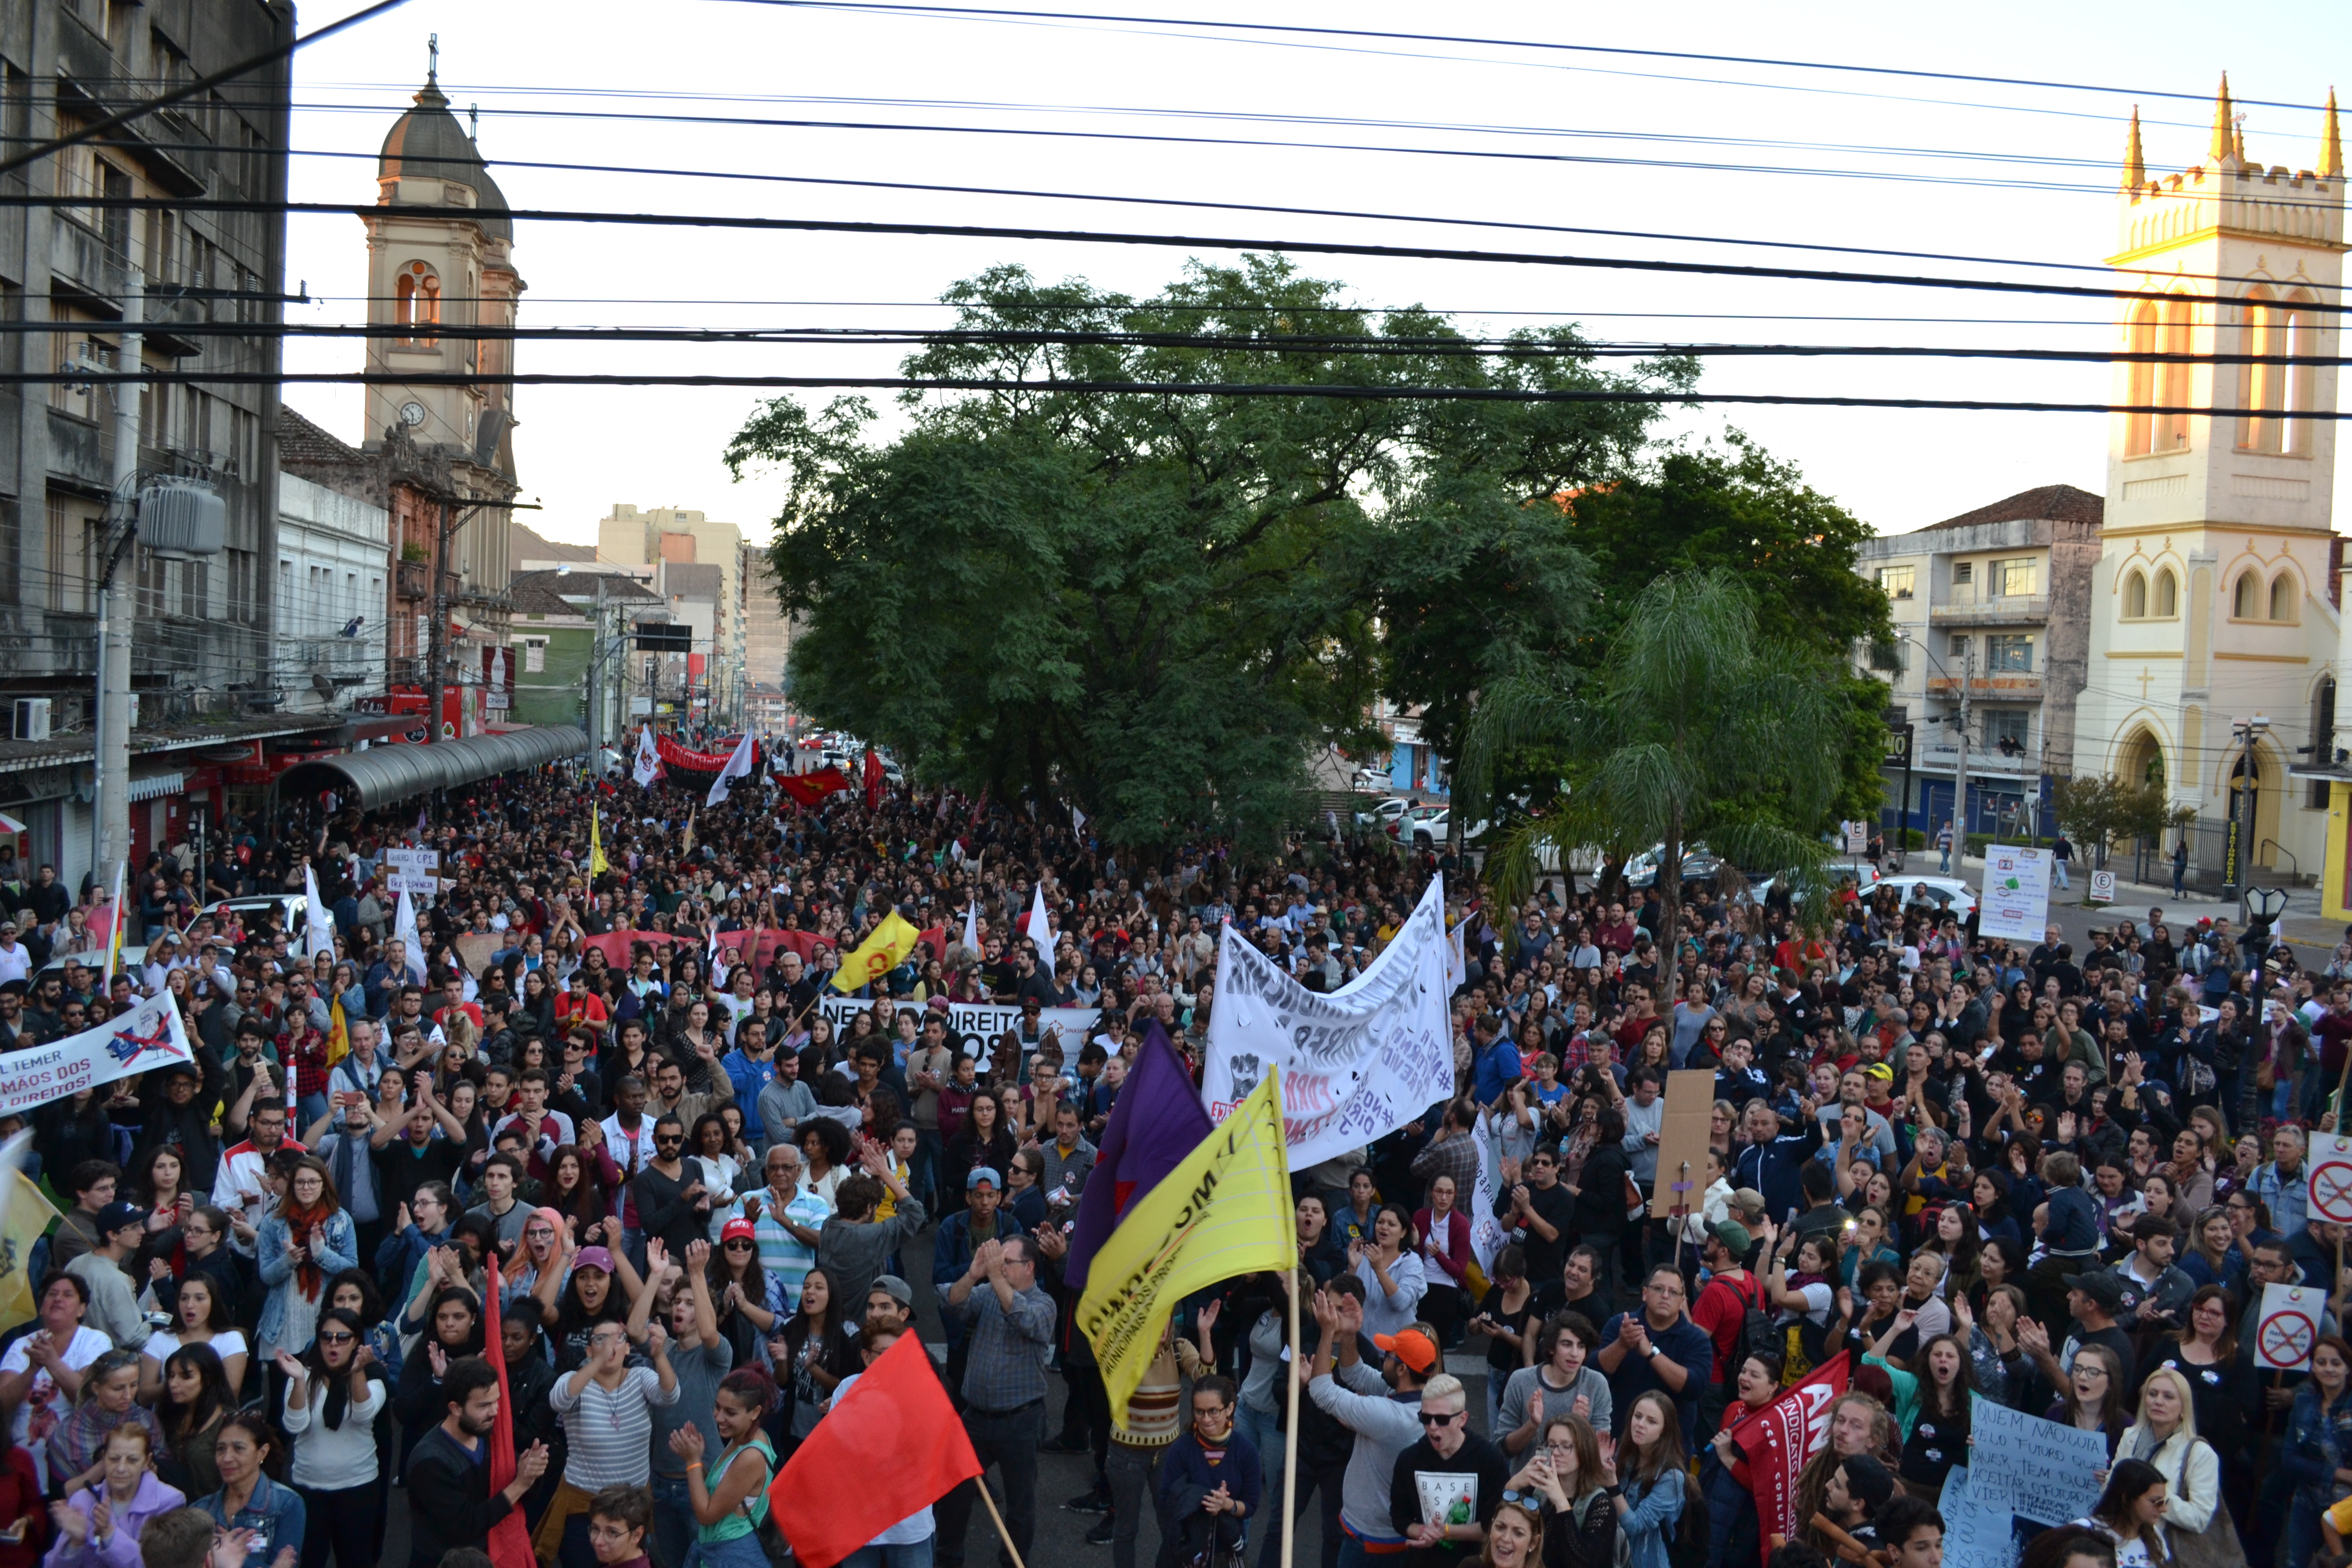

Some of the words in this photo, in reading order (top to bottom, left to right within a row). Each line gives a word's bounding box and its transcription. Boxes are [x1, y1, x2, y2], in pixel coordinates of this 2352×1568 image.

[389, 853, 409, 861] QUERO
[417, 854, 434, 864] CPI
[2100, 876, 2106, 886] E
[1, 1071, 51, 1095] MÃOS
[58, 1058, 91, 1080] DOS
[14, 1050, 62, 1070] TEMER
[10, 1074, 91, 1107] DIREITOS!
[1761, 1419, 1778, 1448] CSP
[1779, 1398, 1800, 1473] SINDICATO
[1977, 1402, 2023, 1431] QUEM
[2032, 1422, 2065, 1443] NÃO
[2068, 1435, 2100, 1454] LUTA
[1973, 1425, 2006, 1446] PELO
[2015, 1436, 2065, 1462] FUTURO
[2072, 1455, 2105, 1472] QUE
[1422, 1481, 1469, 1491] BASE
[1971, 1467, 2026, 1492] ACEITAR
[2031, 1482, 2040, 1494] O
[2040, 1484, 2085, 1504] FUTURO
[2017, 1458, 2050, 1479] TEM
[2059, 1471, 2099, 1493] QUE
[1972, 1484, 2016, 1512] VIER!
